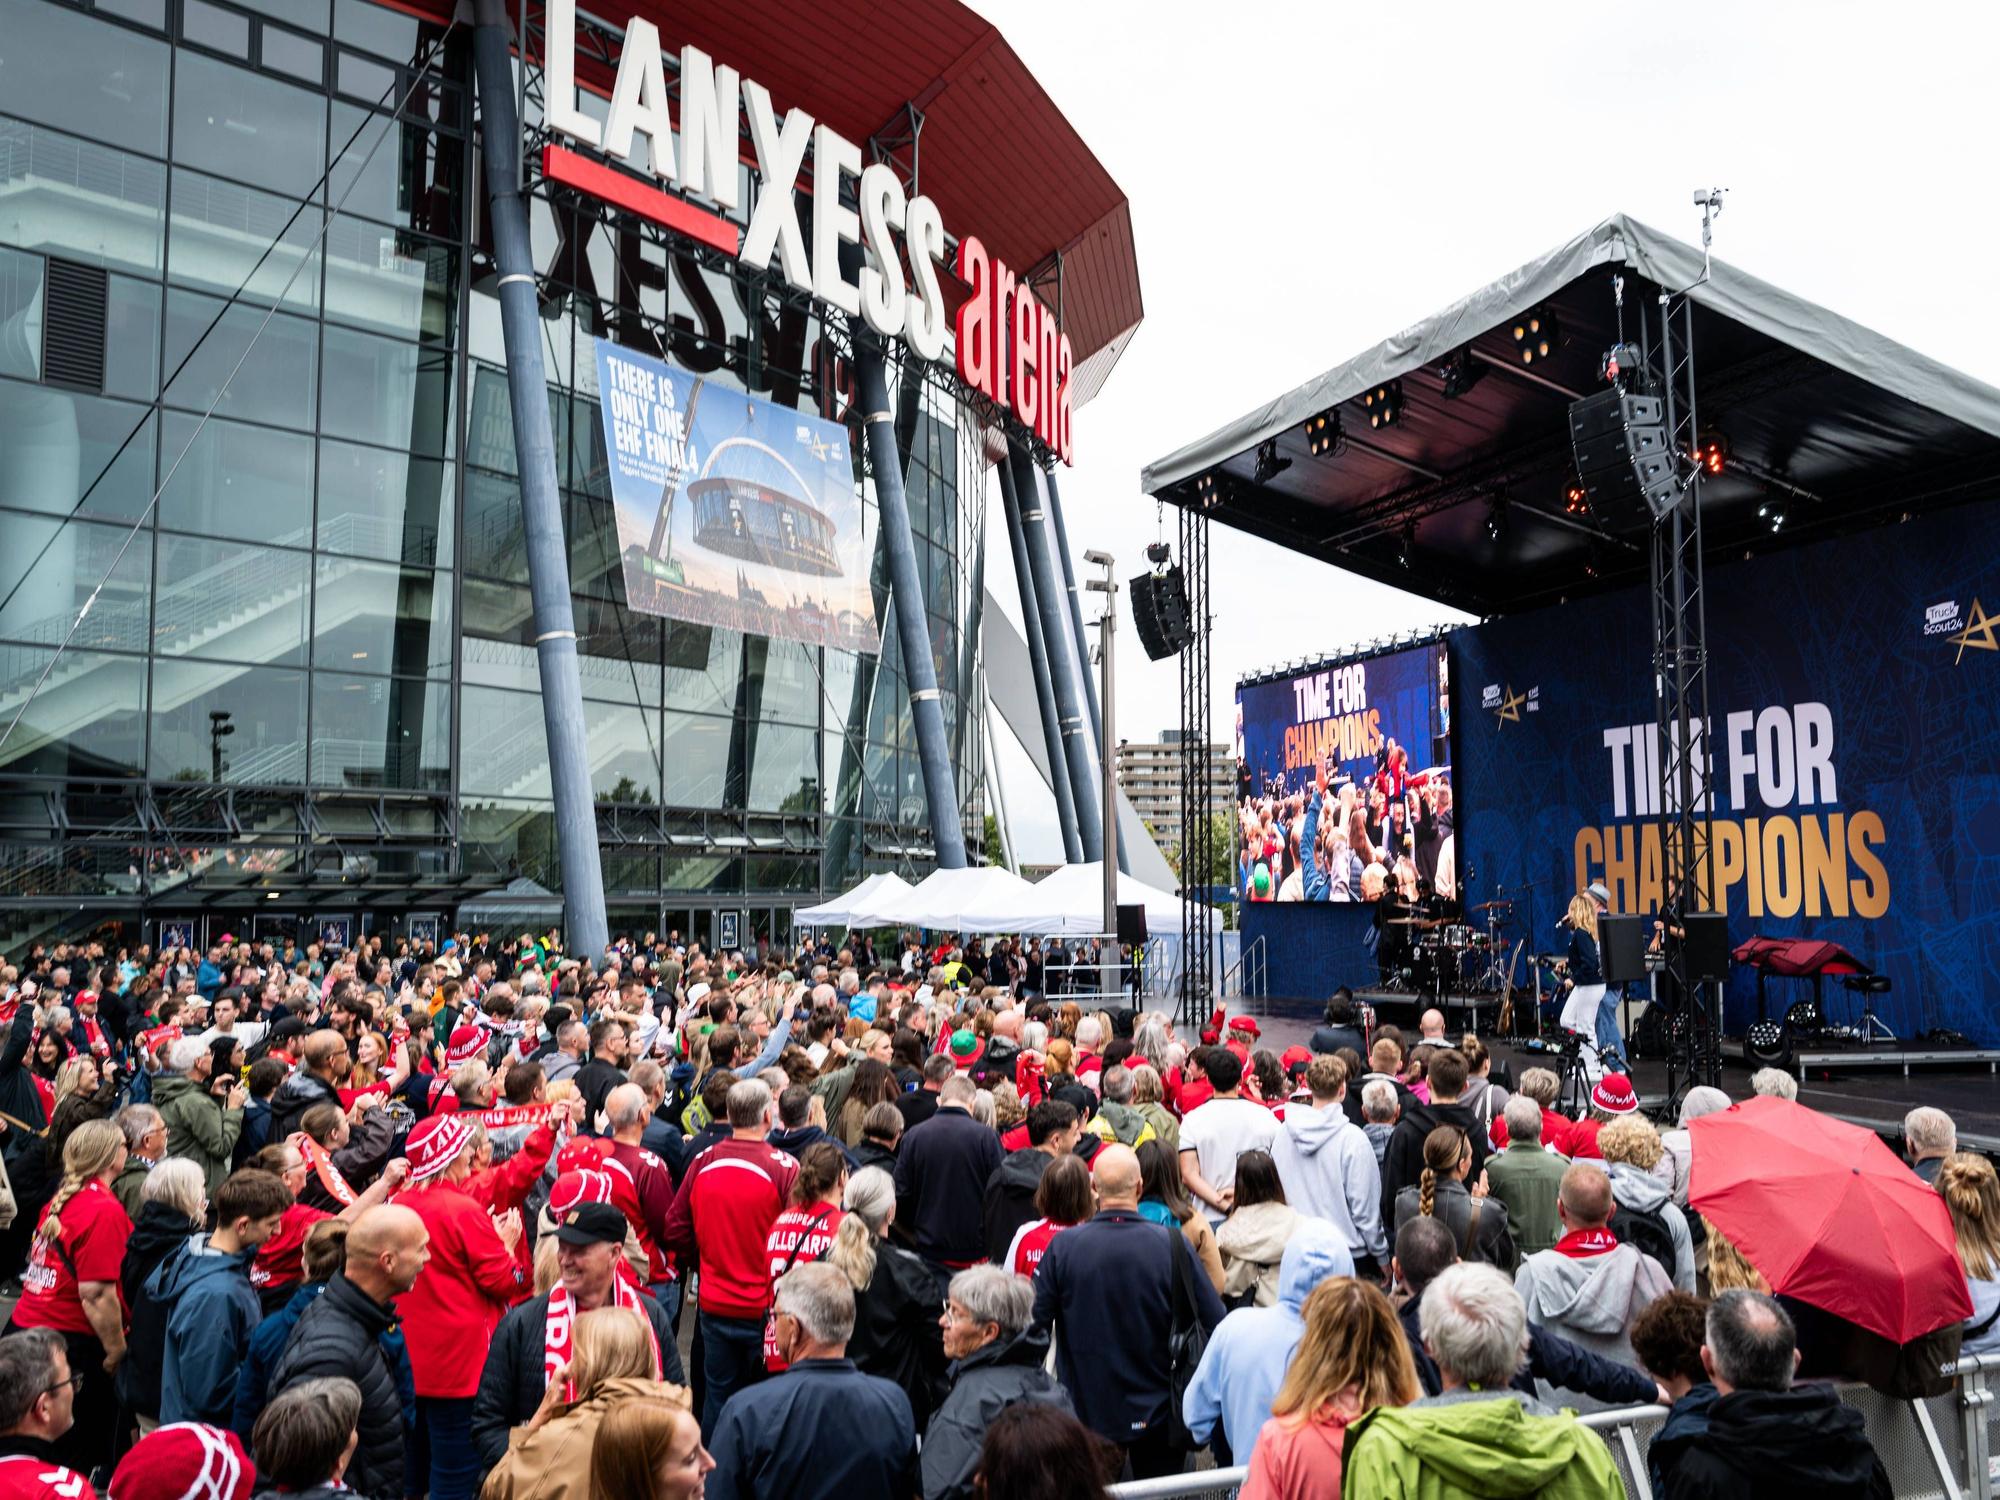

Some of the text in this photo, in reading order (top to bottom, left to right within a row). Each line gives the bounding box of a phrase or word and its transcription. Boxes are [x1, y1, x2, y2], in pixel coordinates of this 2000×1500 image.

[544, 0, 947, 361] LANXESS
[956, 236, 1074, 467] arena
[607, 355, 676, 409] THERE IS
[610, 387, 686, 442] ONLY ONE
[613, 420, 643, 457] EHF
[1923, 618, 1964, 635] Scout24
[1929, 605, 1956, 619] Truck
[1293, 663, 1367, 724] TIME FOR
[1285, 708, 1381, 770] CHAMPIONS
[1727, 702, 1838, 810] FOR
